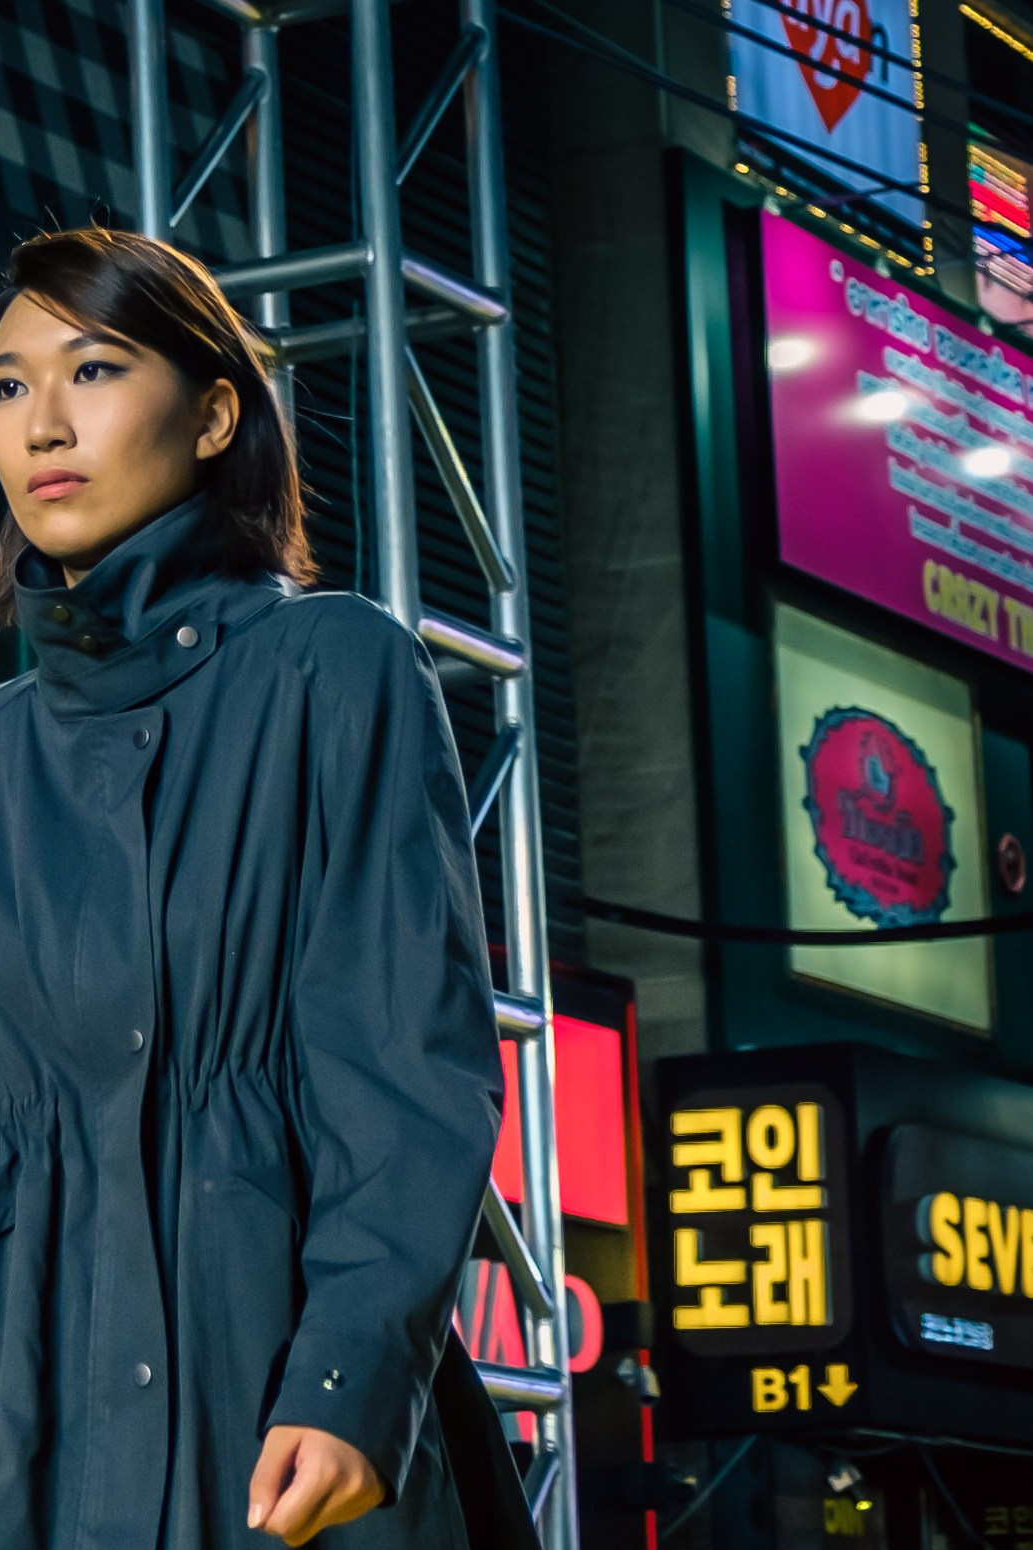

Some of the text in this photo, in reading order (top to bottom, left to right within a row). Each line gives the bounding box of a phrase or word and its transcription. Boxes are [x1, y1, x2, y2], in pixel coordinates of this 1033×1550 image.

[670, 1102, 824, 1213] 코인
[673, 1218, 829, 1329] 노래
[751, 1364, 812, 1412] B1
